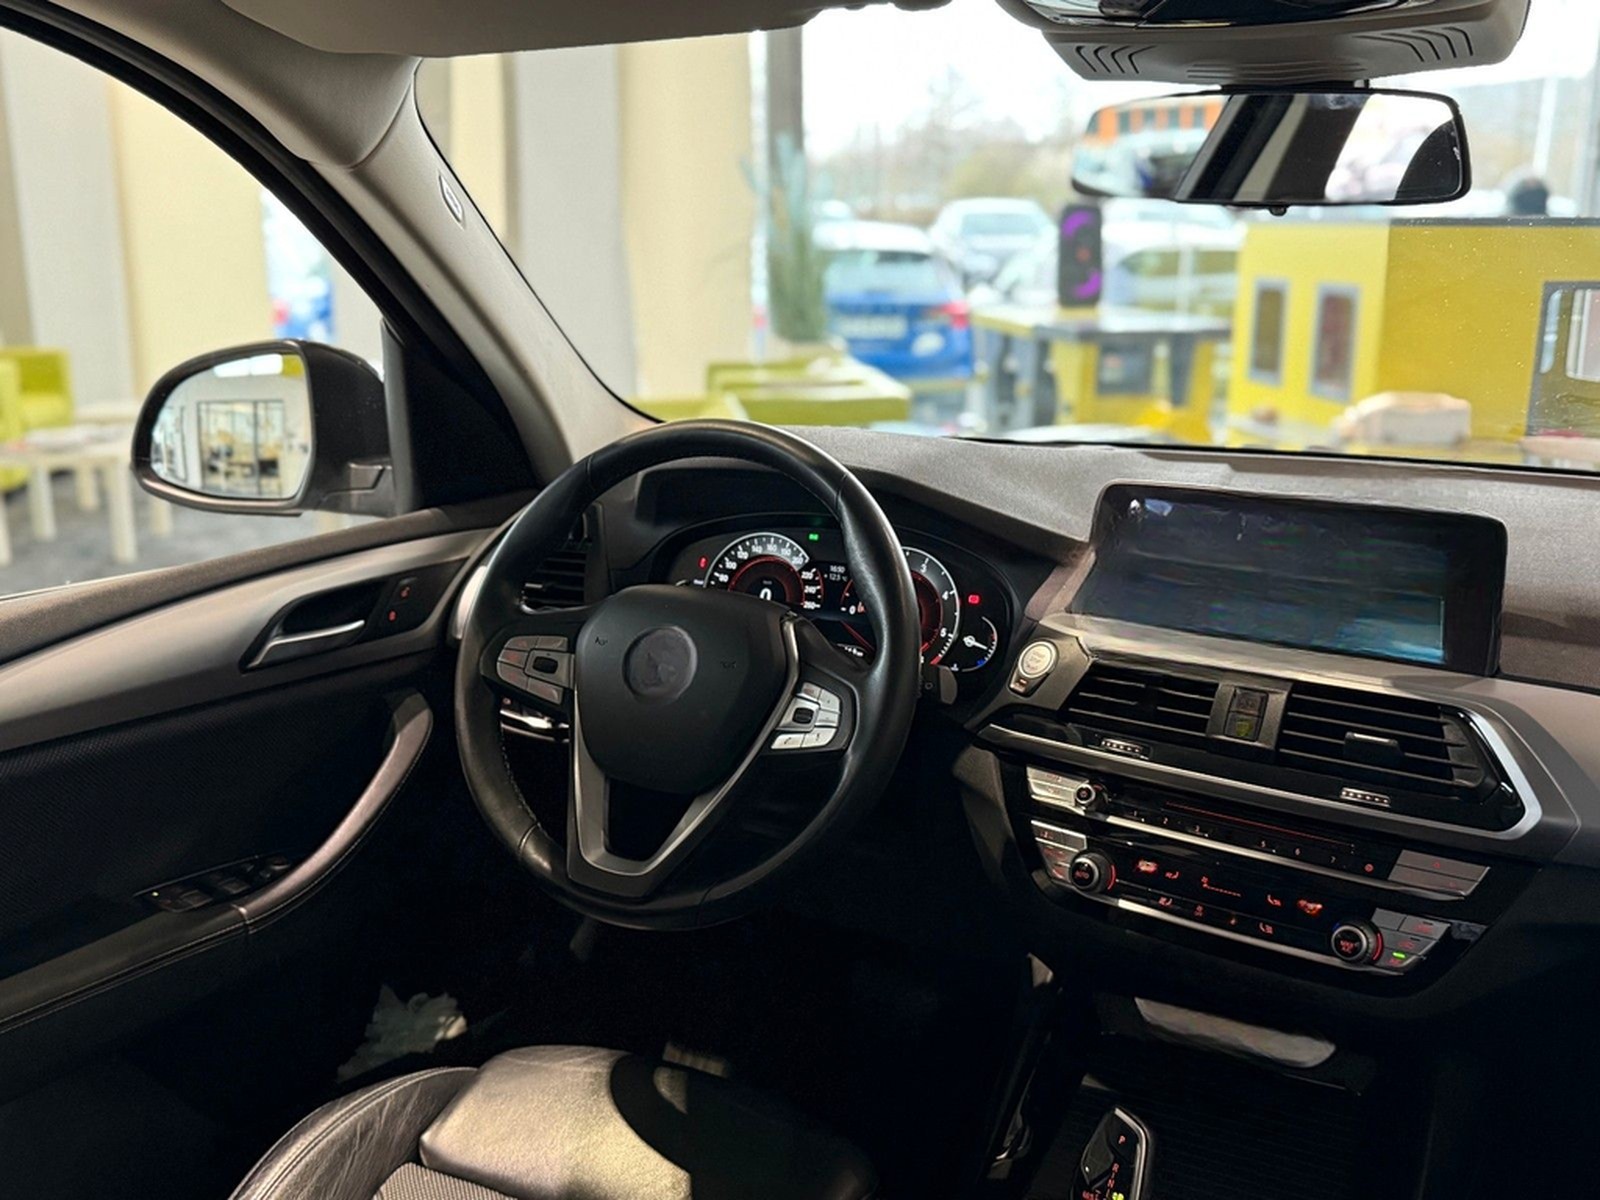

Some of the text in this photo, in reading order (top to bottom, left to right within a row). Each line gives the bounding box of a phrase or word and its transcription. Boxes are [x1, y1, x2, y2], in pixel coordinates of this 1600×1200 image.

[737, 551, 749, 560] 120
[725, 561, 737, 570] 100
[920, 563, 927, 573] 3
[719, 574, 729, 583] 80
[801, 571, 814, 580] 220
[804, 585, 817, 594] 240
[942, 591, 949, 600] 4
[849, 605, 856, 615] 0
[940, 628, 947, 637] 5
[1118, 1135, 1126, 1144] P
[1112, 1163, 1119, 1173] R
[1107, 1179, 1115, 1188] N
